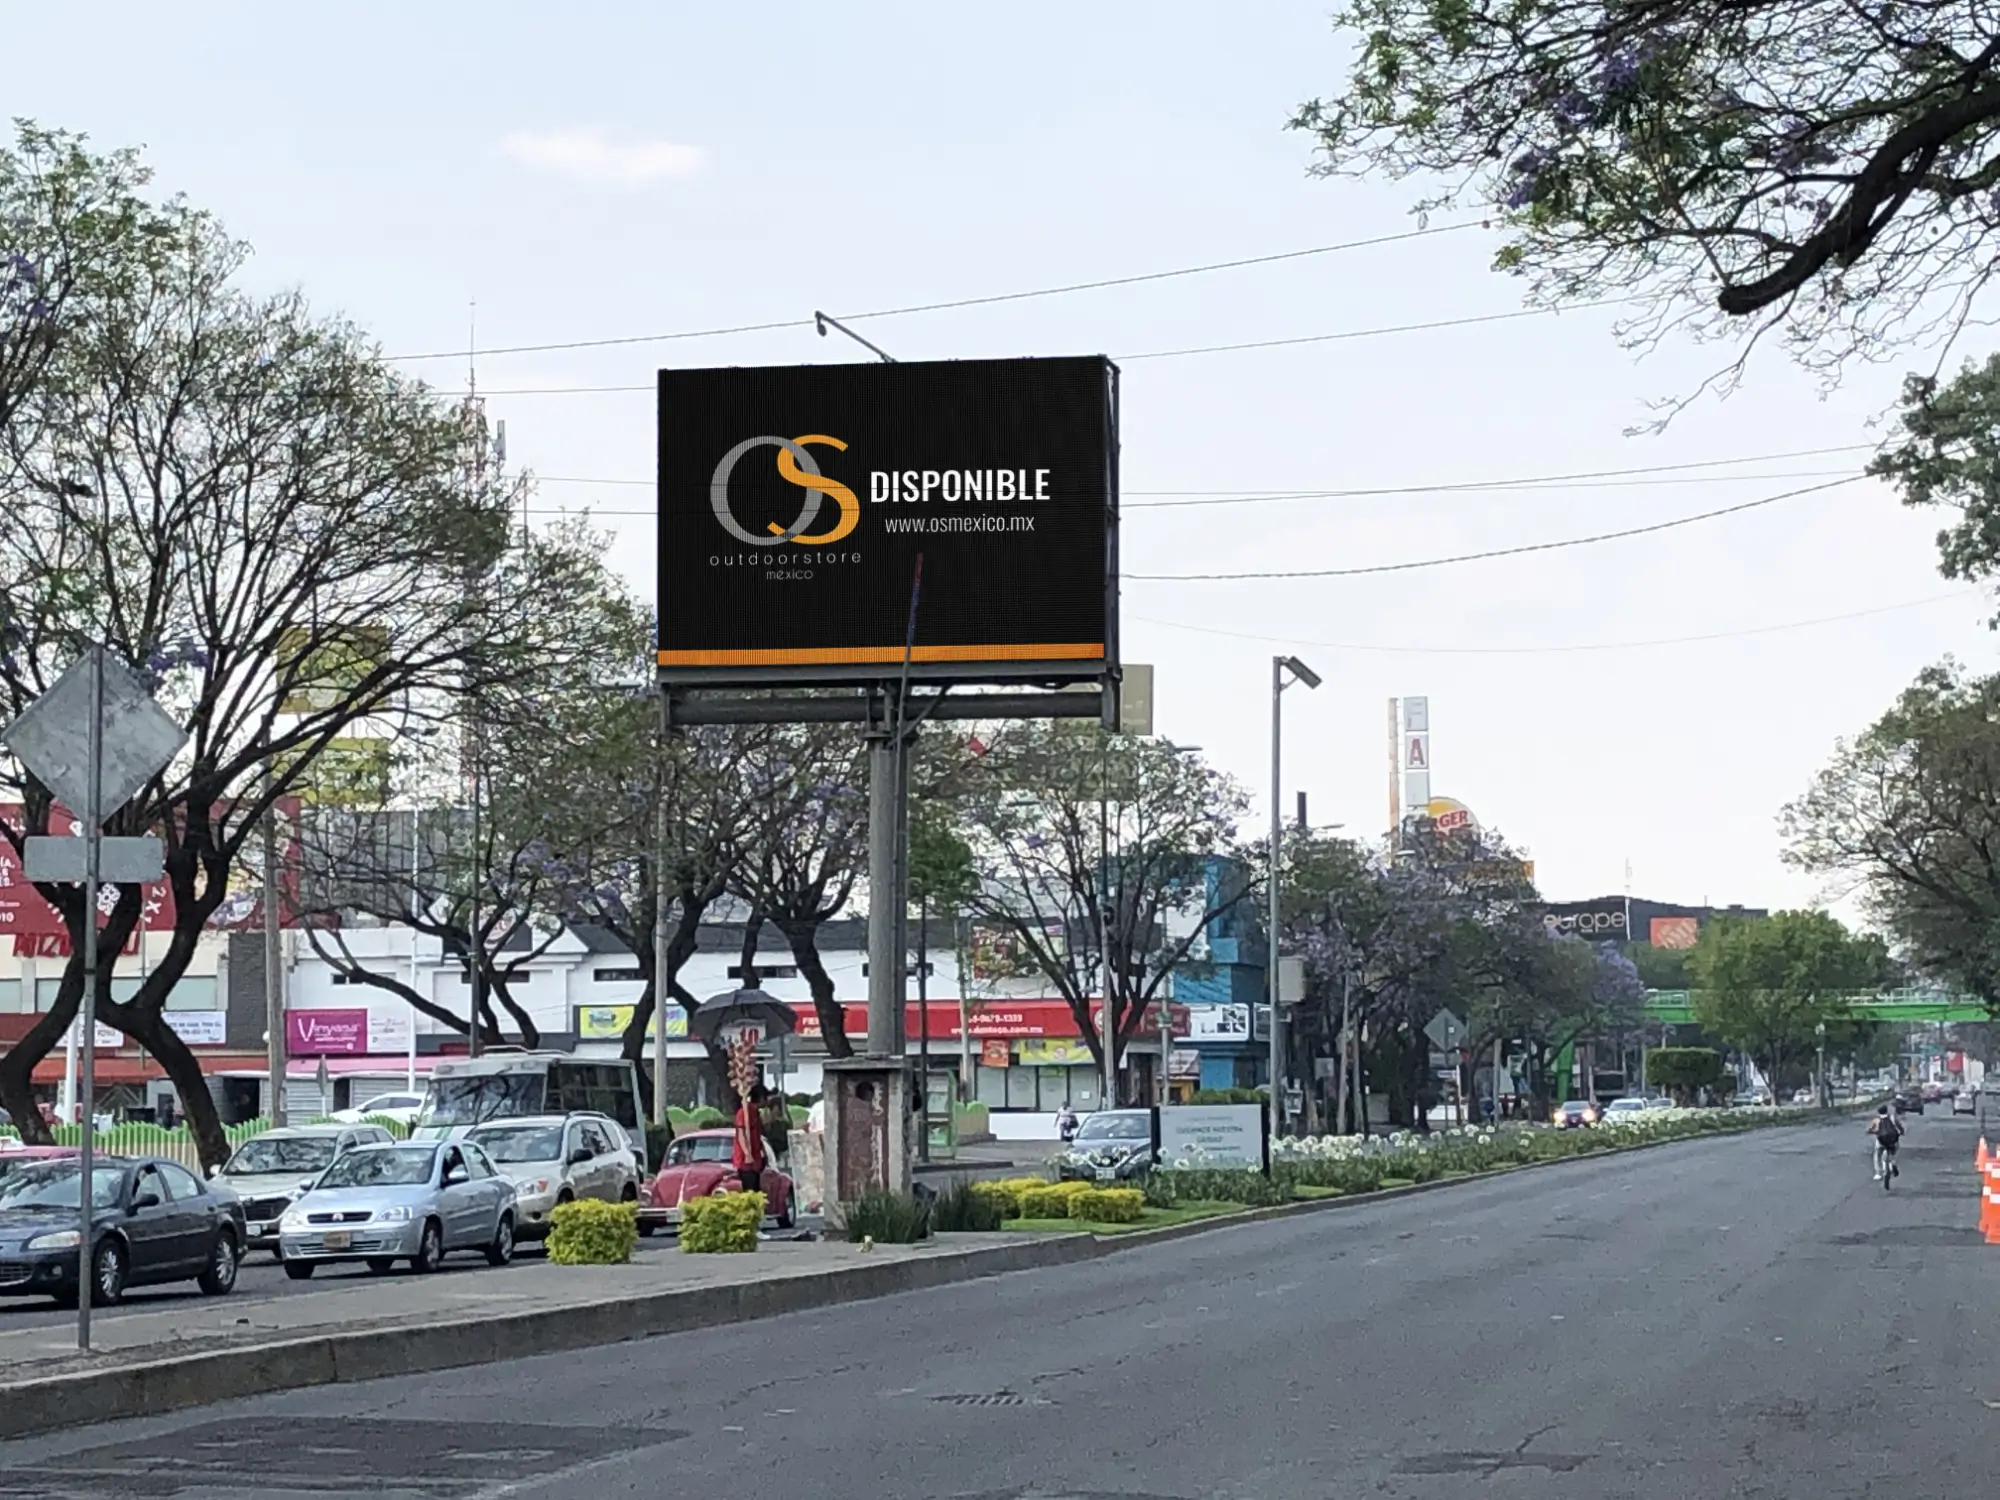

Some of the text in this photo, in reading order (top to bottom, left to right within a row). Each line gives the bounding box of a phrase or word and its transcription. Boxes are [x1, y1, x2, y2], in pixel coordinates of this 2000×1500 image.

[710, 434, 860, 546] OS
[870, 469, 1051, 503] DISPONIBLE
[885, 513, 1035, 533] www.osmexico.mx
[709, 552, 861, 566] outdoorstore
[766, 569, 814, 580] mexico
[1409, 738, 1425, 765] A
